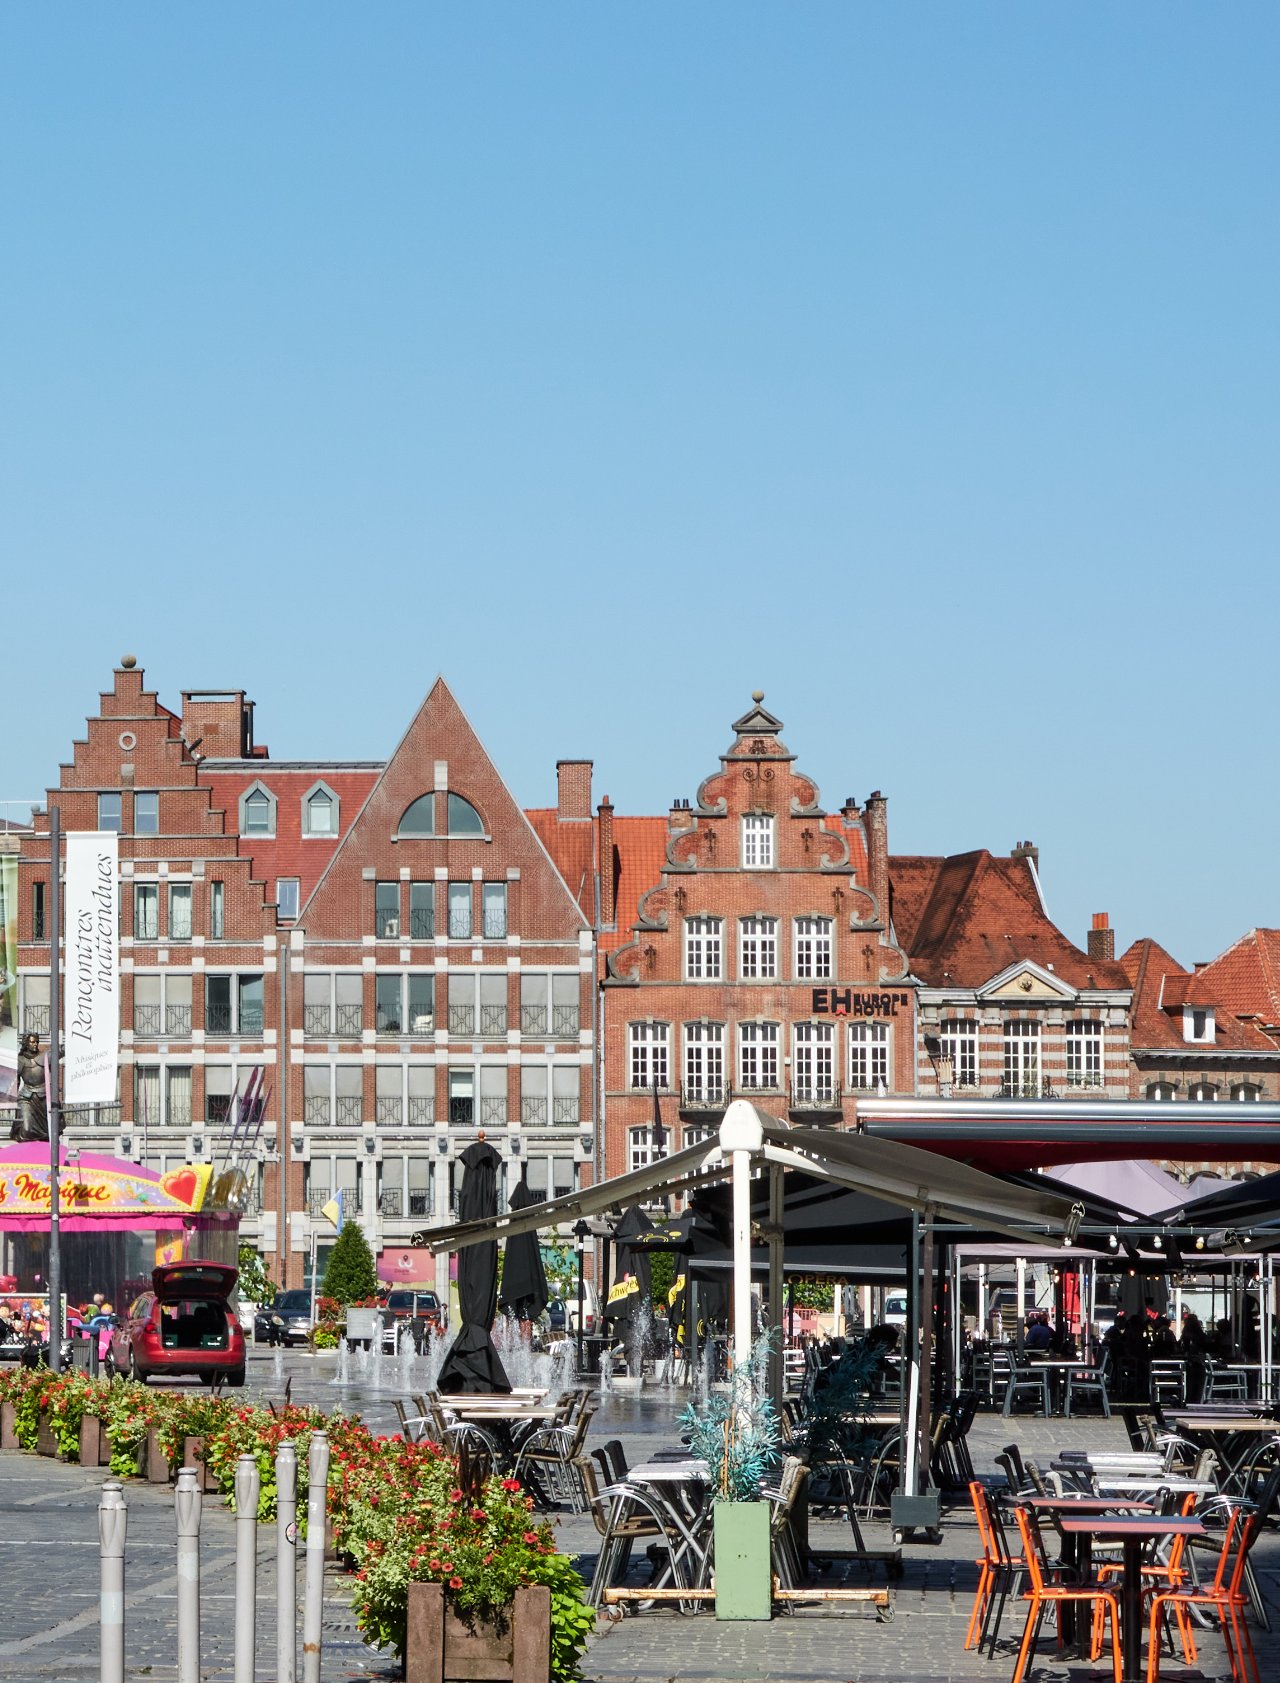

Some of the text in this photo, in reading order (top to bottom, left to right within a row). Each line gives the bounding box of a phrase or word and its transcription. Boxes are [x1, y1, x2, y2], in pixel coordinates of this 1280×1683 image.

[92, 853, 112, 992] inattendues
[72, 909, 95, 1043] Rencontres
[853, 993, 908, 1007] EUROPE
[853, 1003, 898, 1016] HOTEL
